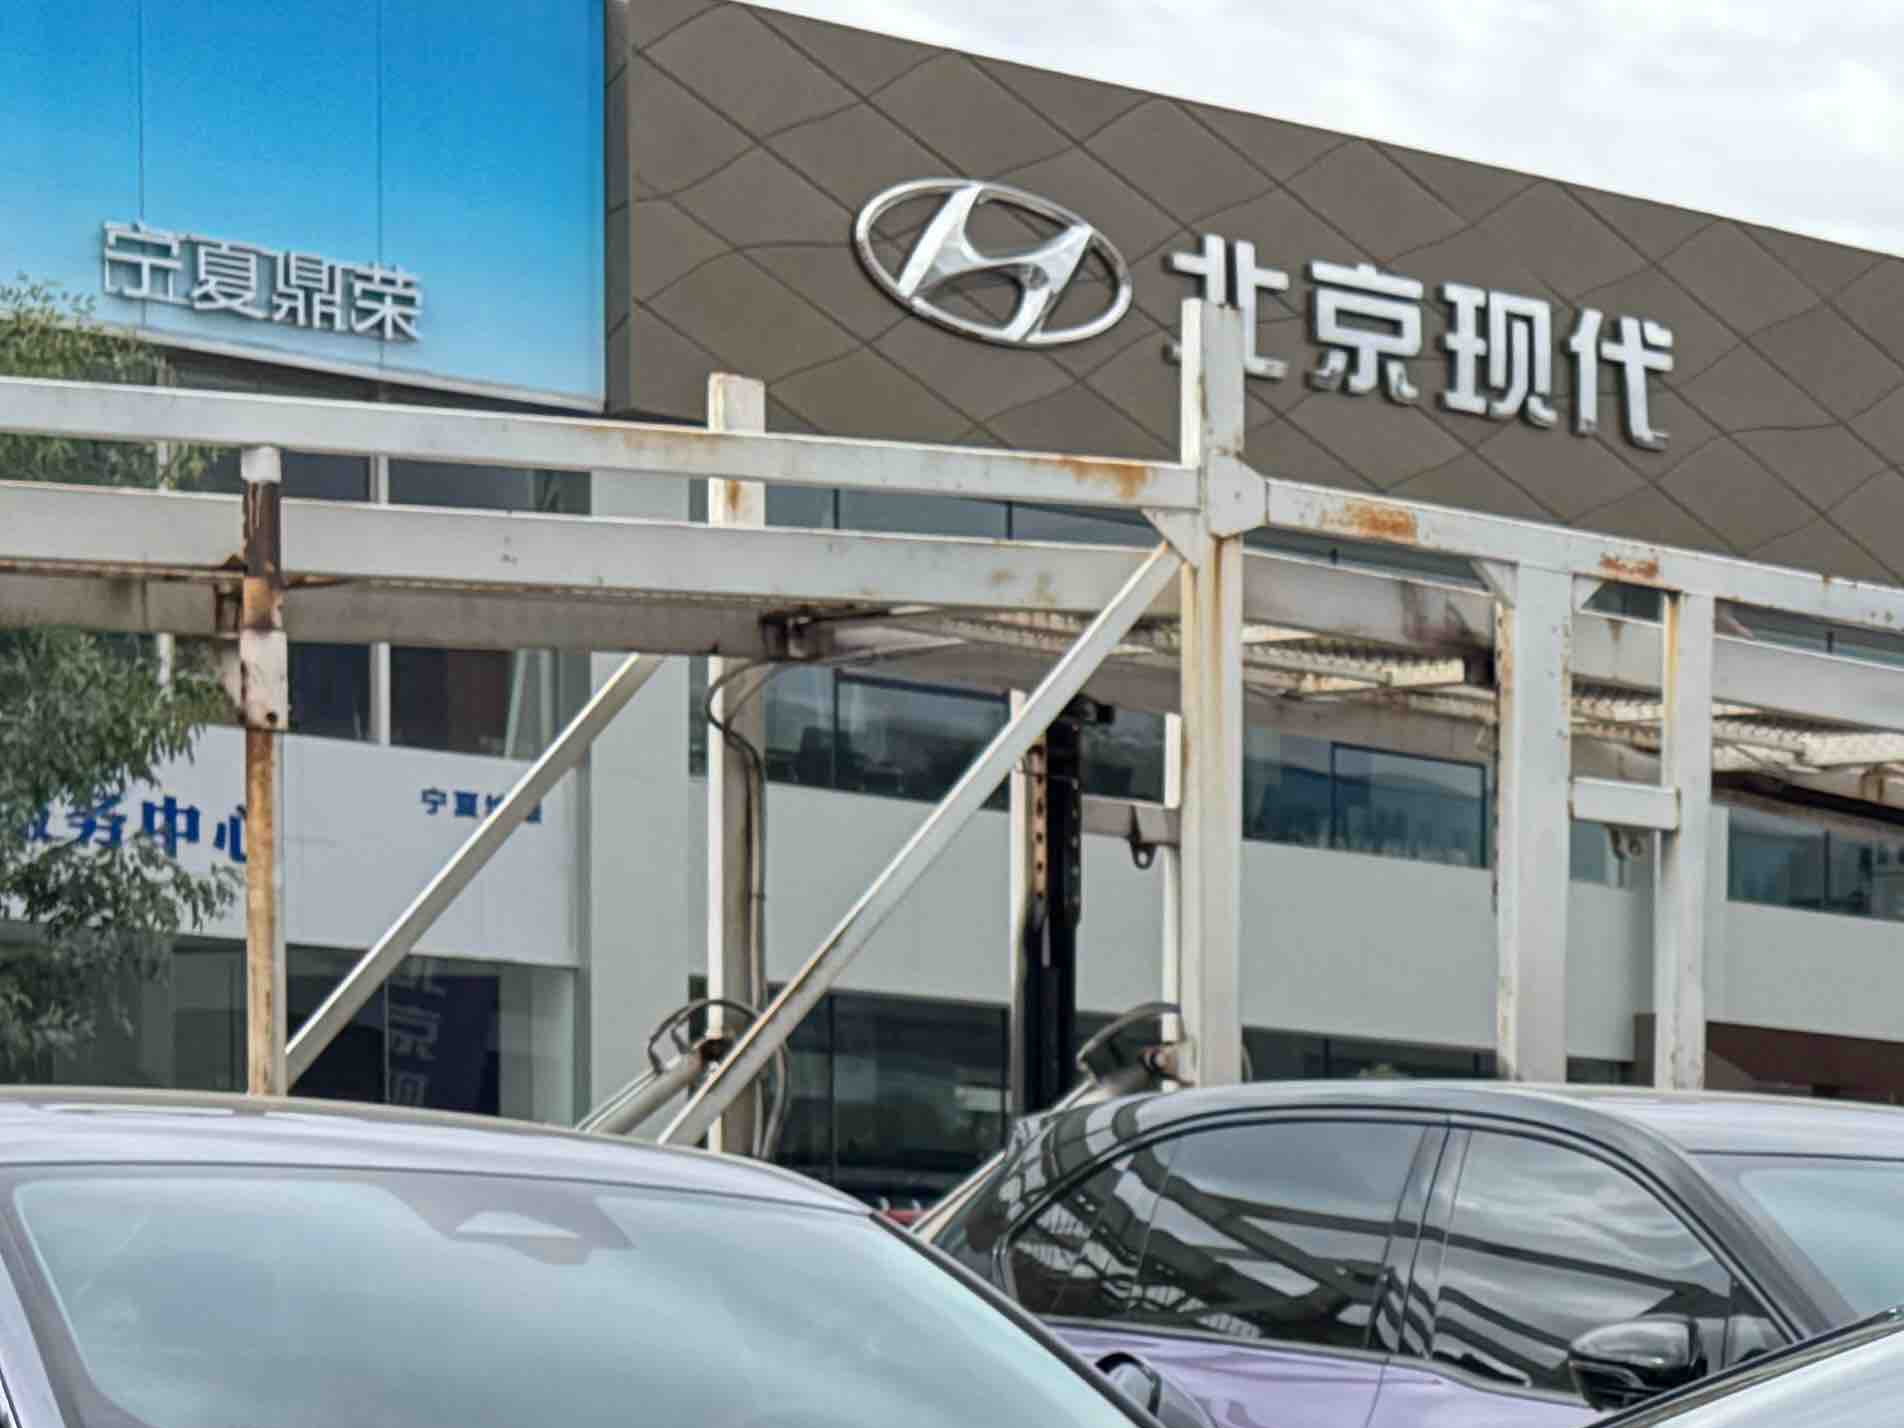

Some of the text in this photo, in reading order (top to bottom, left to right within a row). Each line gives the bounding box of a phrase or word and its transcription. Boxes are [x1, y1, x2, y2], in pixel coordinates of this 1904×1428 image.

[103, 220, 424, 341] 宁夏鼎荣
[1166, 233, 1674, 450] 北京现代
